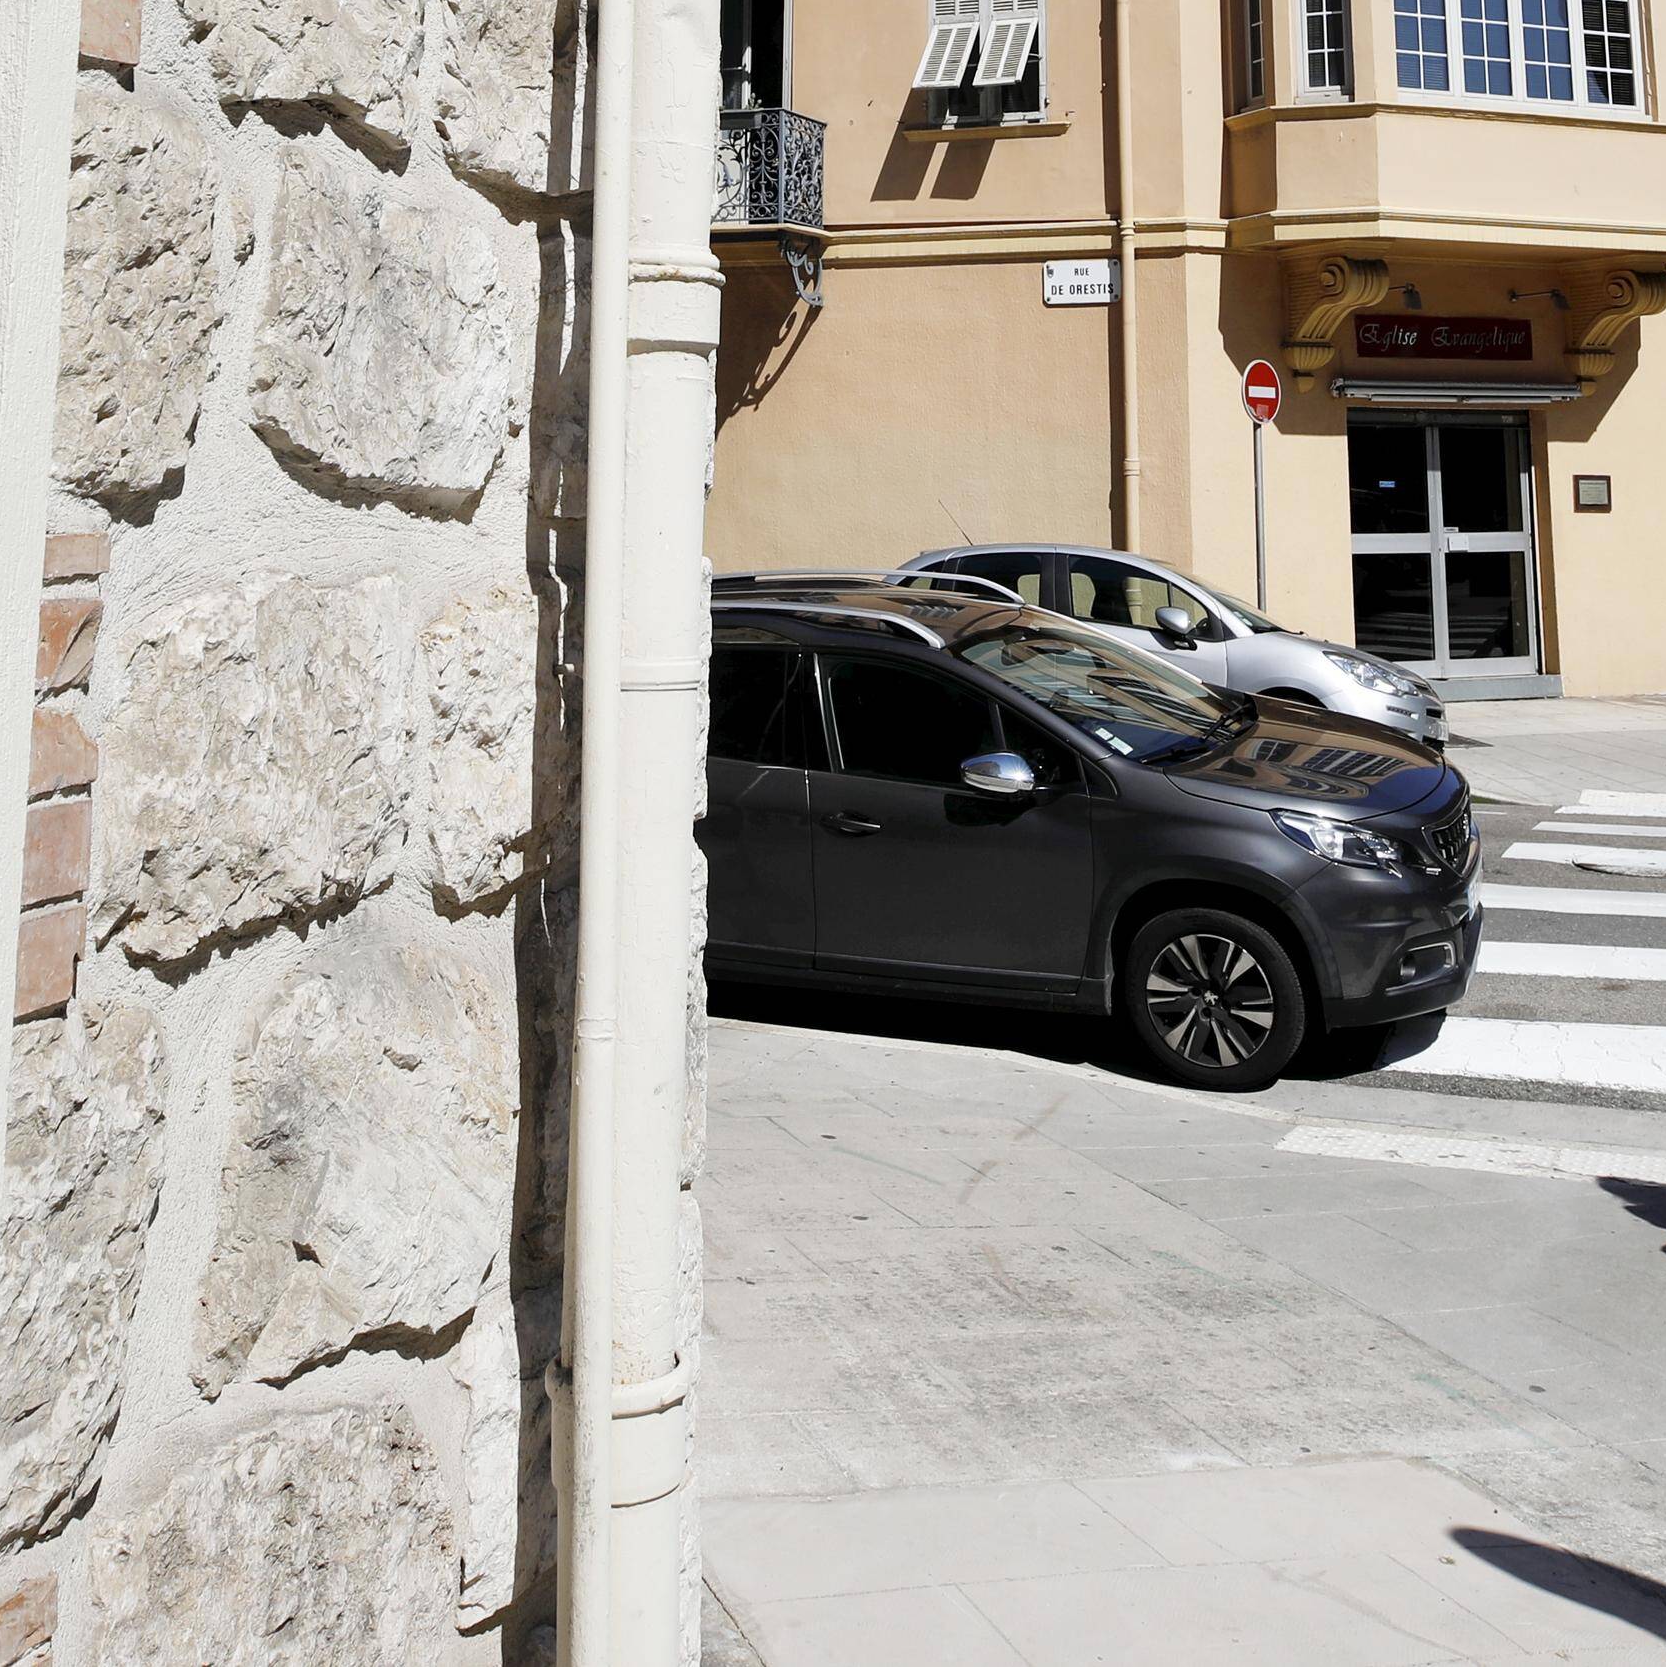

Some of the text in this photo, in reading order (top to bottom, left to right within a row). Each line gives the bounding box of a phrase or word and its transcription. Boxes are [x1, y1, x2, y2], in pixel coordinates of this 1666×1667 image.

[1074, 267, 1090, 276] RUE
[1051, 283, 1114, 295] DE ORESTIS
